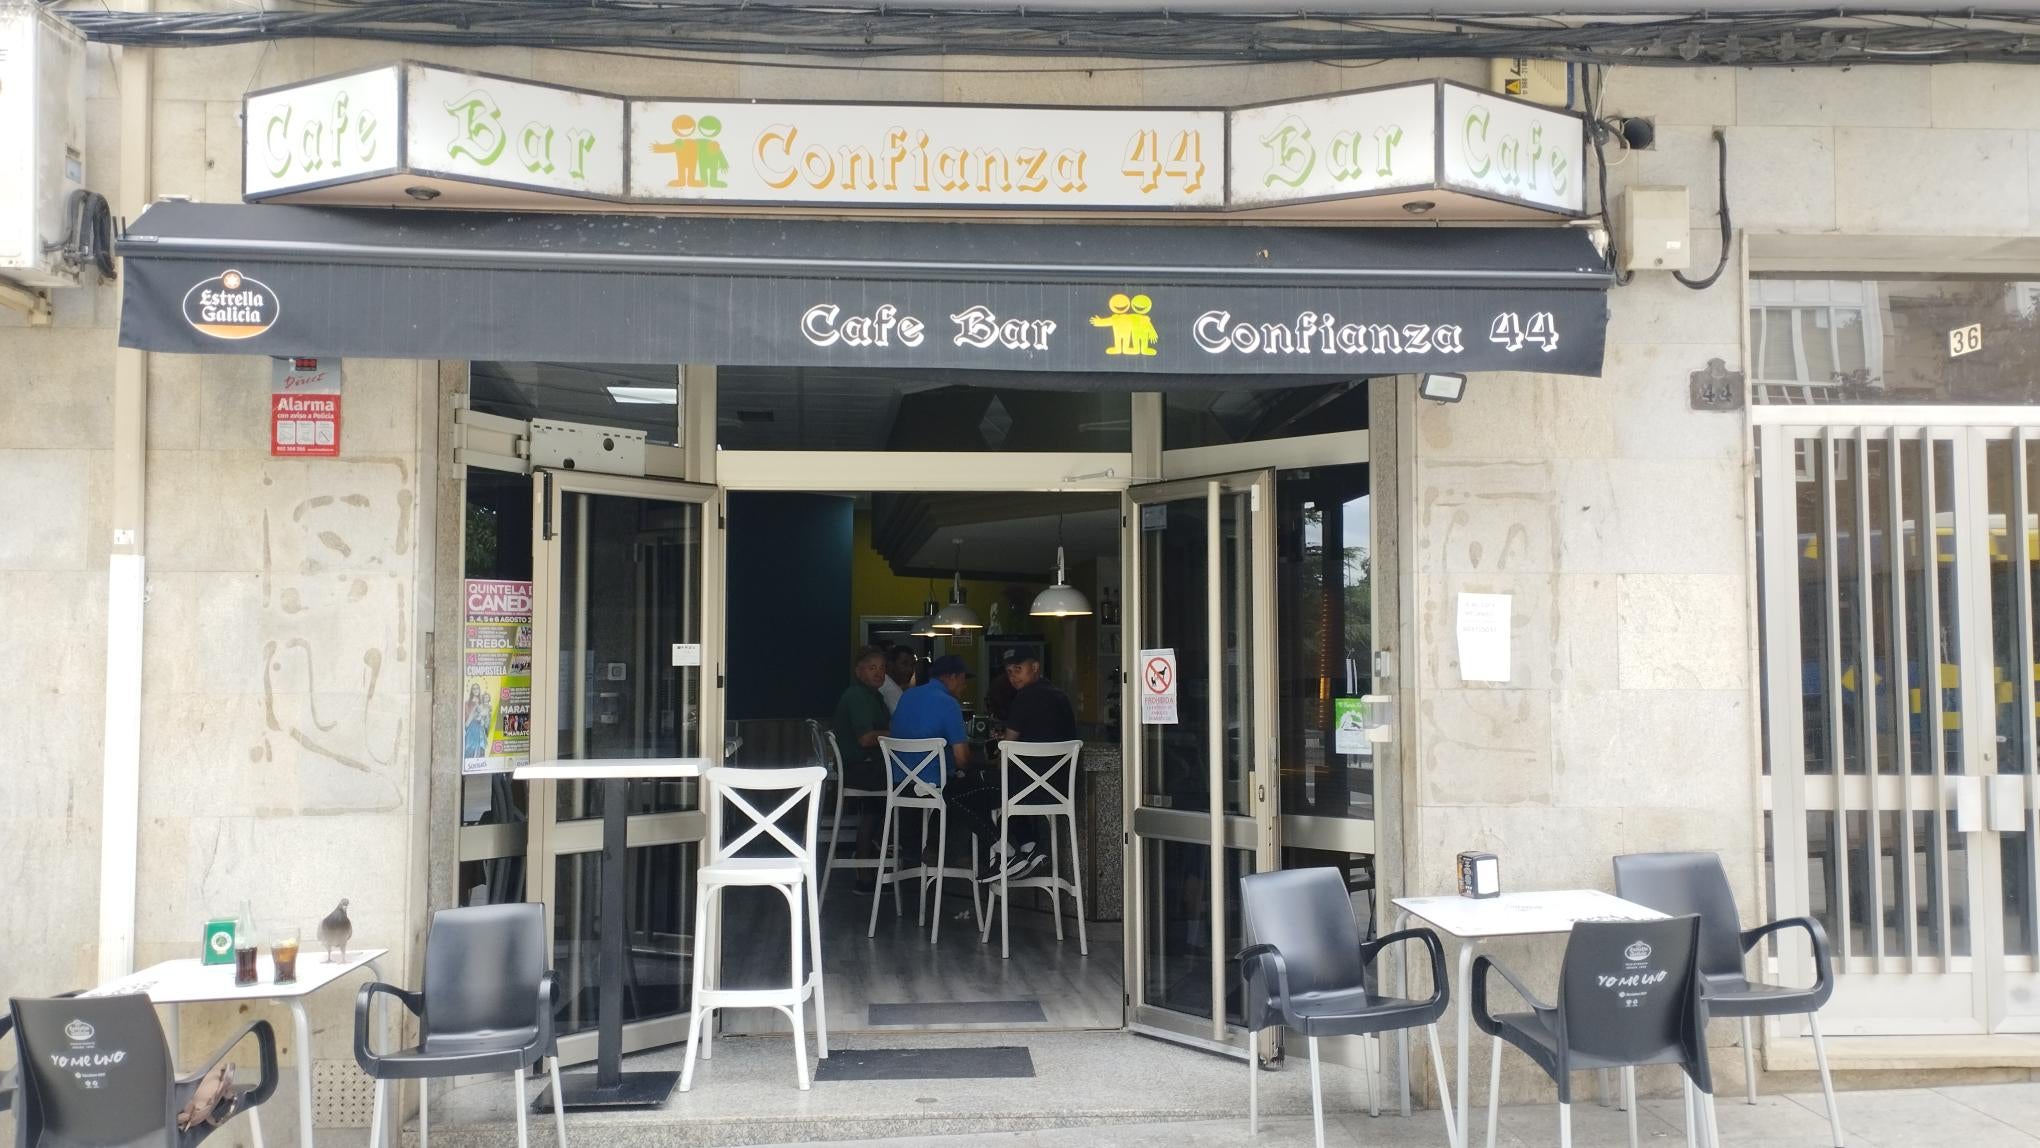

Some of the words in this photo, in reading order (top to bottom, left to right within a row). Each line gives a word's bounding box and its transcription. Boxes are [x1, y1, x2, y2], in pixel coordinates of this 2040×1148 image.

[264, 91, 378, 179] Cafe
[445, 88, 595, 181] Bar
[752, 123, 1088, 193] Confianza
[1121, 129, 1205, 193] 44
[1259, 115, 1403, 189] Bar
[1462, 105, 1568, 196] Cafe
[200, 289, 264, 307] Estrella
[202, 306, 261, 323] Galicia
[800, 304, 925, 348] Cafe
[950, 305, 1057, 350] Bar
[1193, 311, 1464, 355] Confianza
[1489, 312, 1560, 352] 44
[1953, 327, 1979, 354] 36
[277, 397, 335, 411] Alarma
[469, 584, 526, 595] QUINTELA
[470, 639, 512, 648] TREBOL
[494, 742, 503, 752] 6
